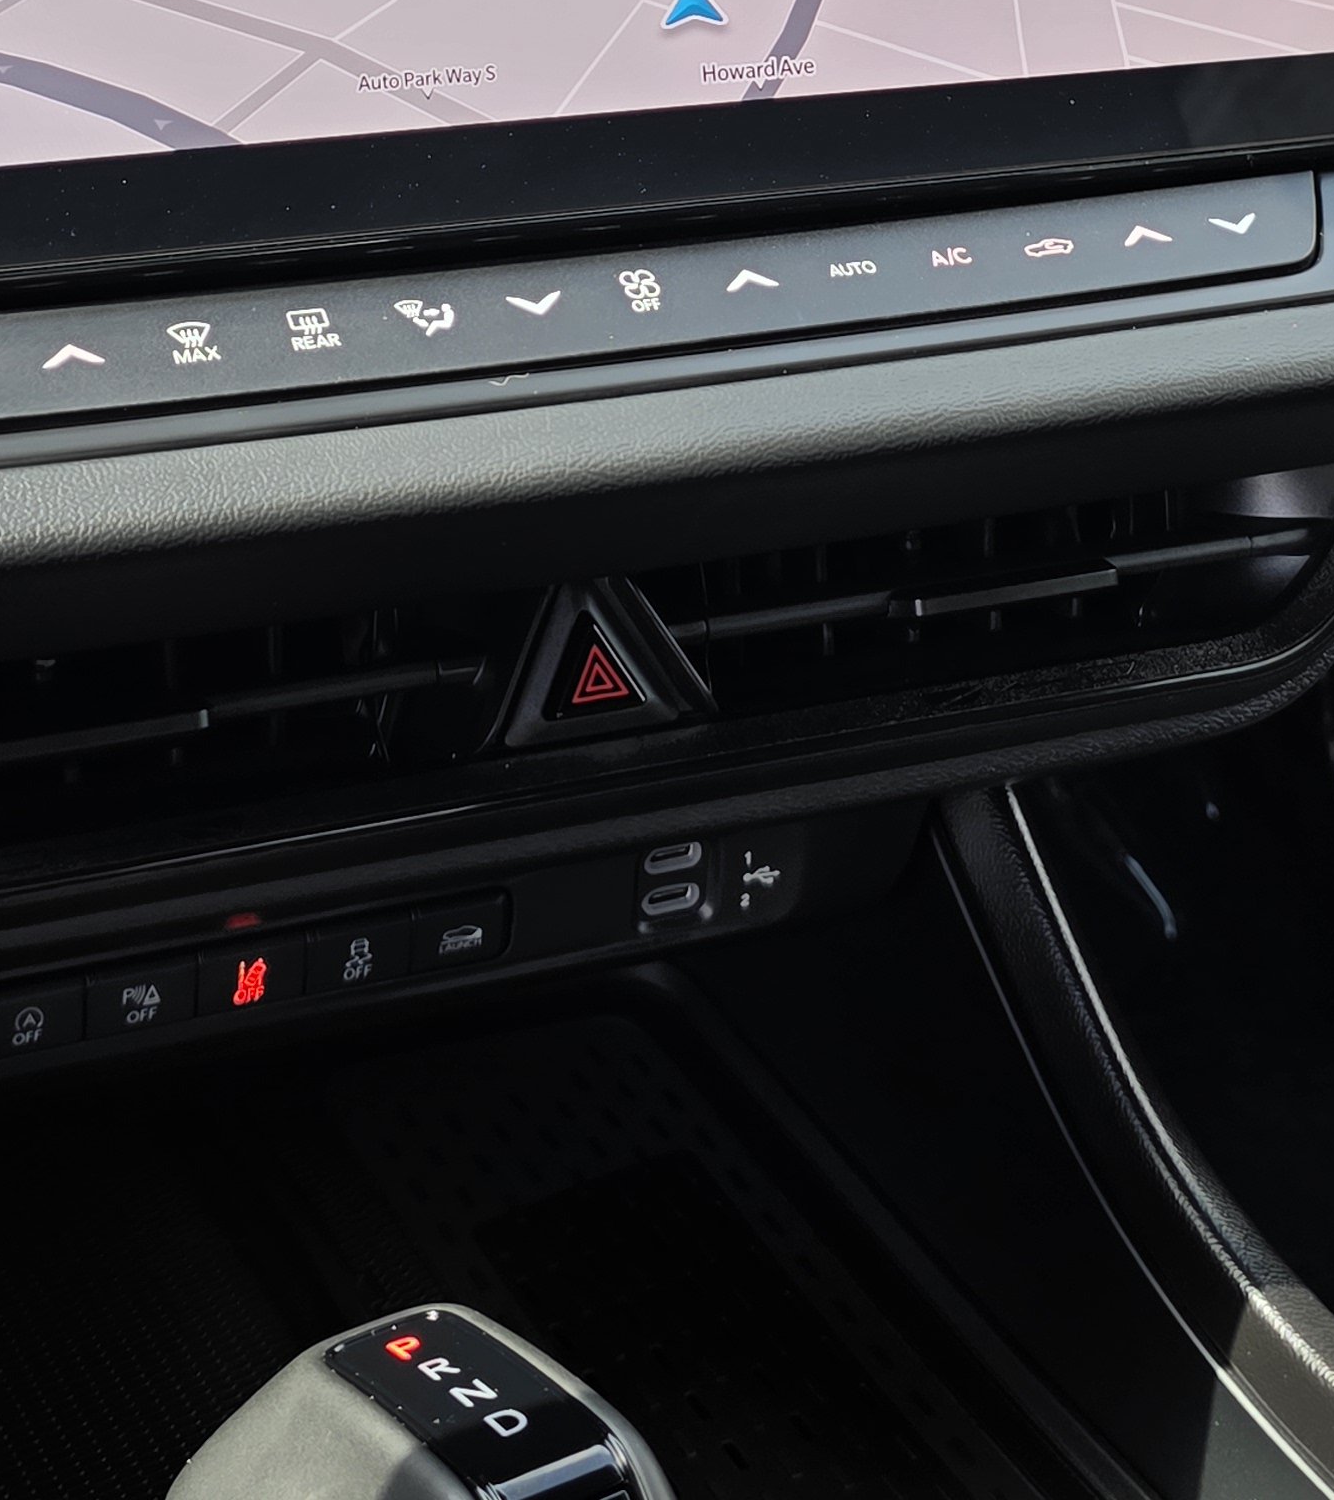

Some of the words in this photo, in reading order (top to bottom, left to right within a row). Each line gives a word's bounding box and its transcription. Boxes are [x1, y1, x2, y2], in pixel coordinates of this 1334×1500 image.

[357, 72, 400, 92] Auto
[403, 69, 441, 89] Park
[444, 68, 481, 88] Way
[483, 65, 496, 82] S
[701, 60, 776, 82] Howard
[780, 57, 815, 77] Ave
[931, 247, 973, 267] A/C
[829, 260, 876, 278] AUTO
[630, 298, 661, 313] OFF
[291, 331, 342, 352] REAR
[172, 345, 221, 366] MAX
[342, 962, 373, 981] OFF
[232, 984, 266, 1006] OFF
[126, 1004, 158, 1025] OFF
[12, 1025, 43, 1046] OFF
[385, 1336, 421, 1361] P
[417, 1357, 461, 1381] R
[448, 1378, 498, 1408] N
[482, 1408, 528, 1437] D
